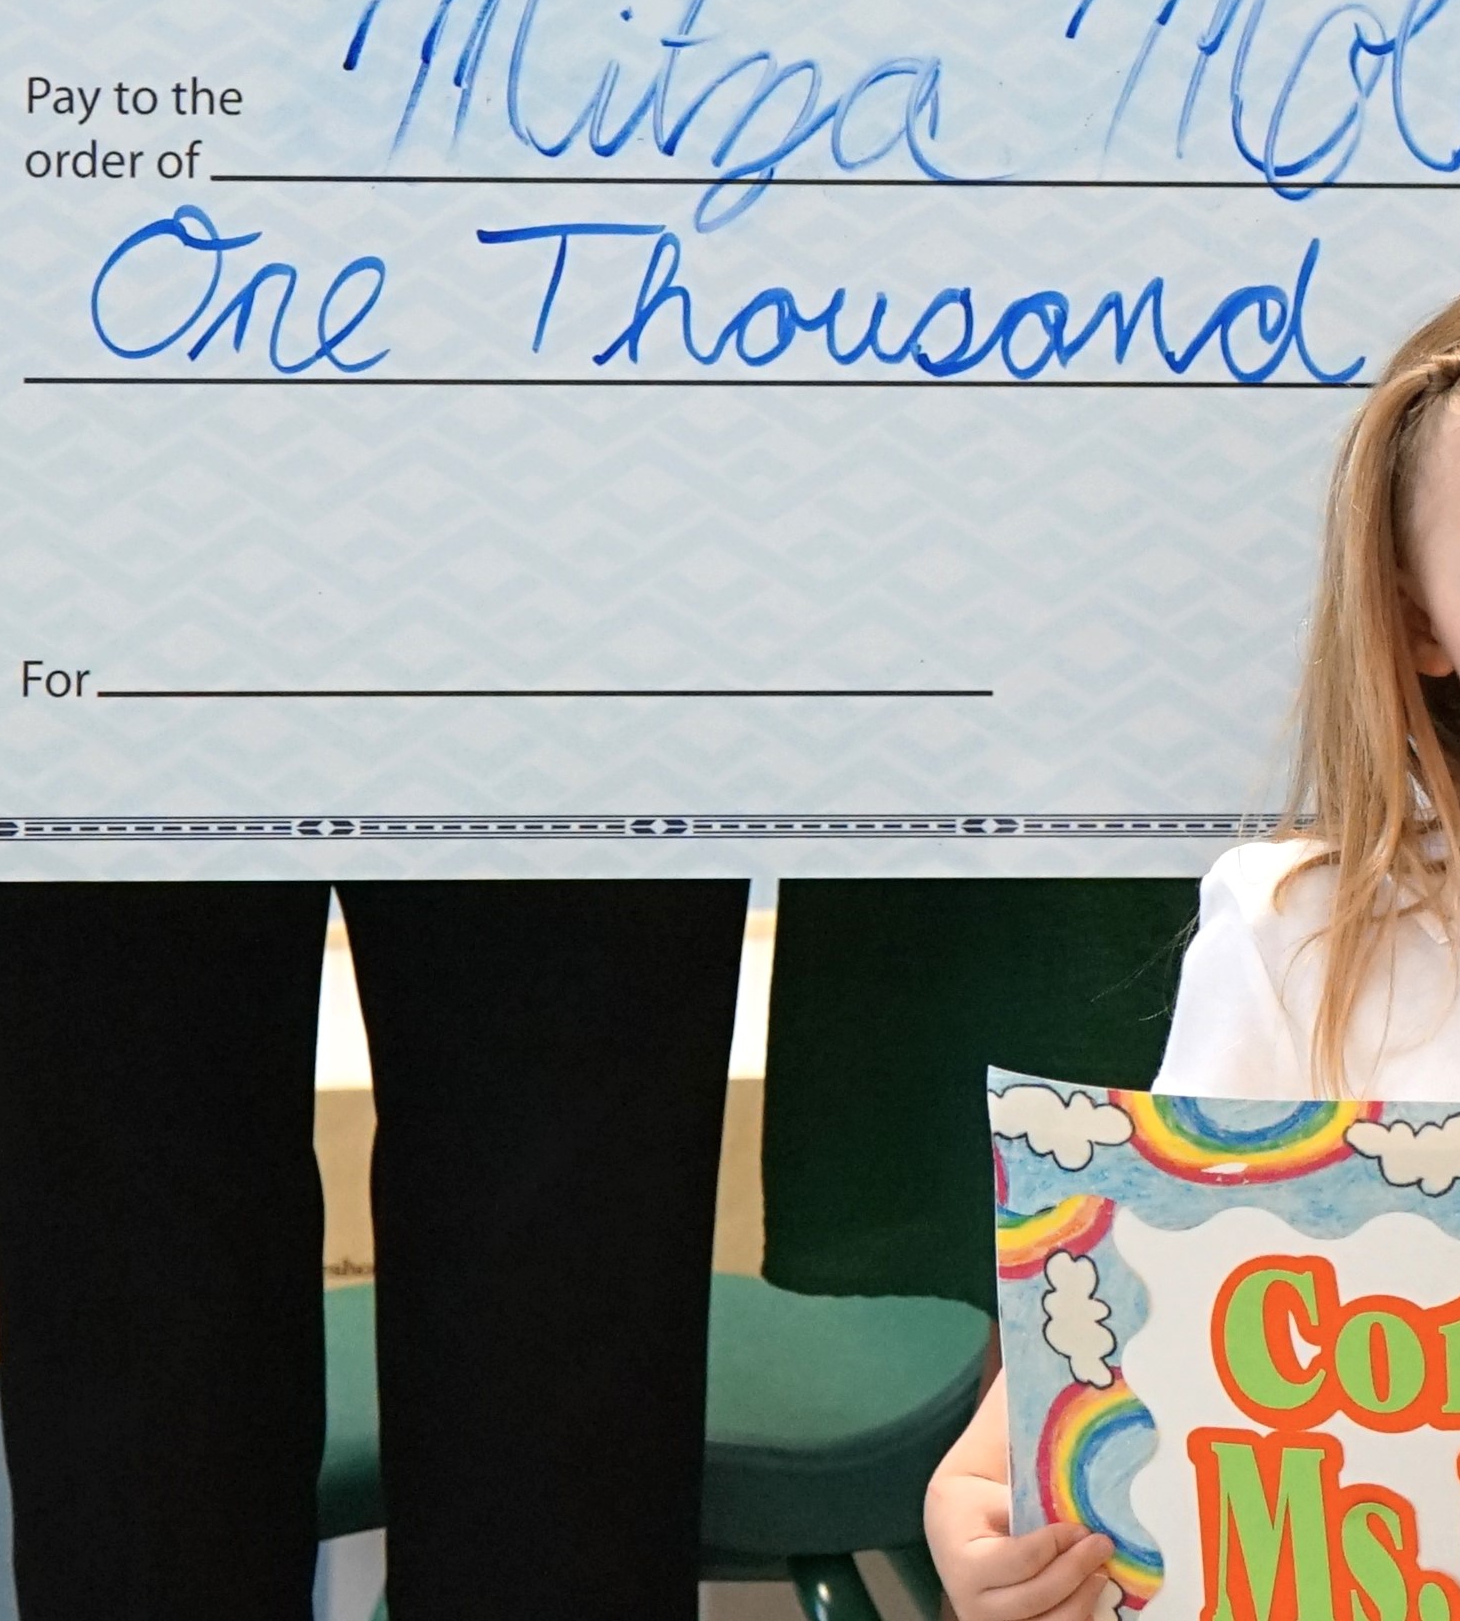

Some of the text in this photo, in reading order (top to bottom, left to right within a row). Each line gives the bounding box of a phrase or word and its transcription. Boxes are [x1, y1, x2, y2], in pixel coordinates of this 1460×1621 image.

[27, 76, 243, 126] Pay to the
[25, 139, 203, 179] order of
[90, 205, 1367, 385] One Thousand
[22, 659, 92, 699] For
[1208, 1441, 1453, 1621] Ms.
